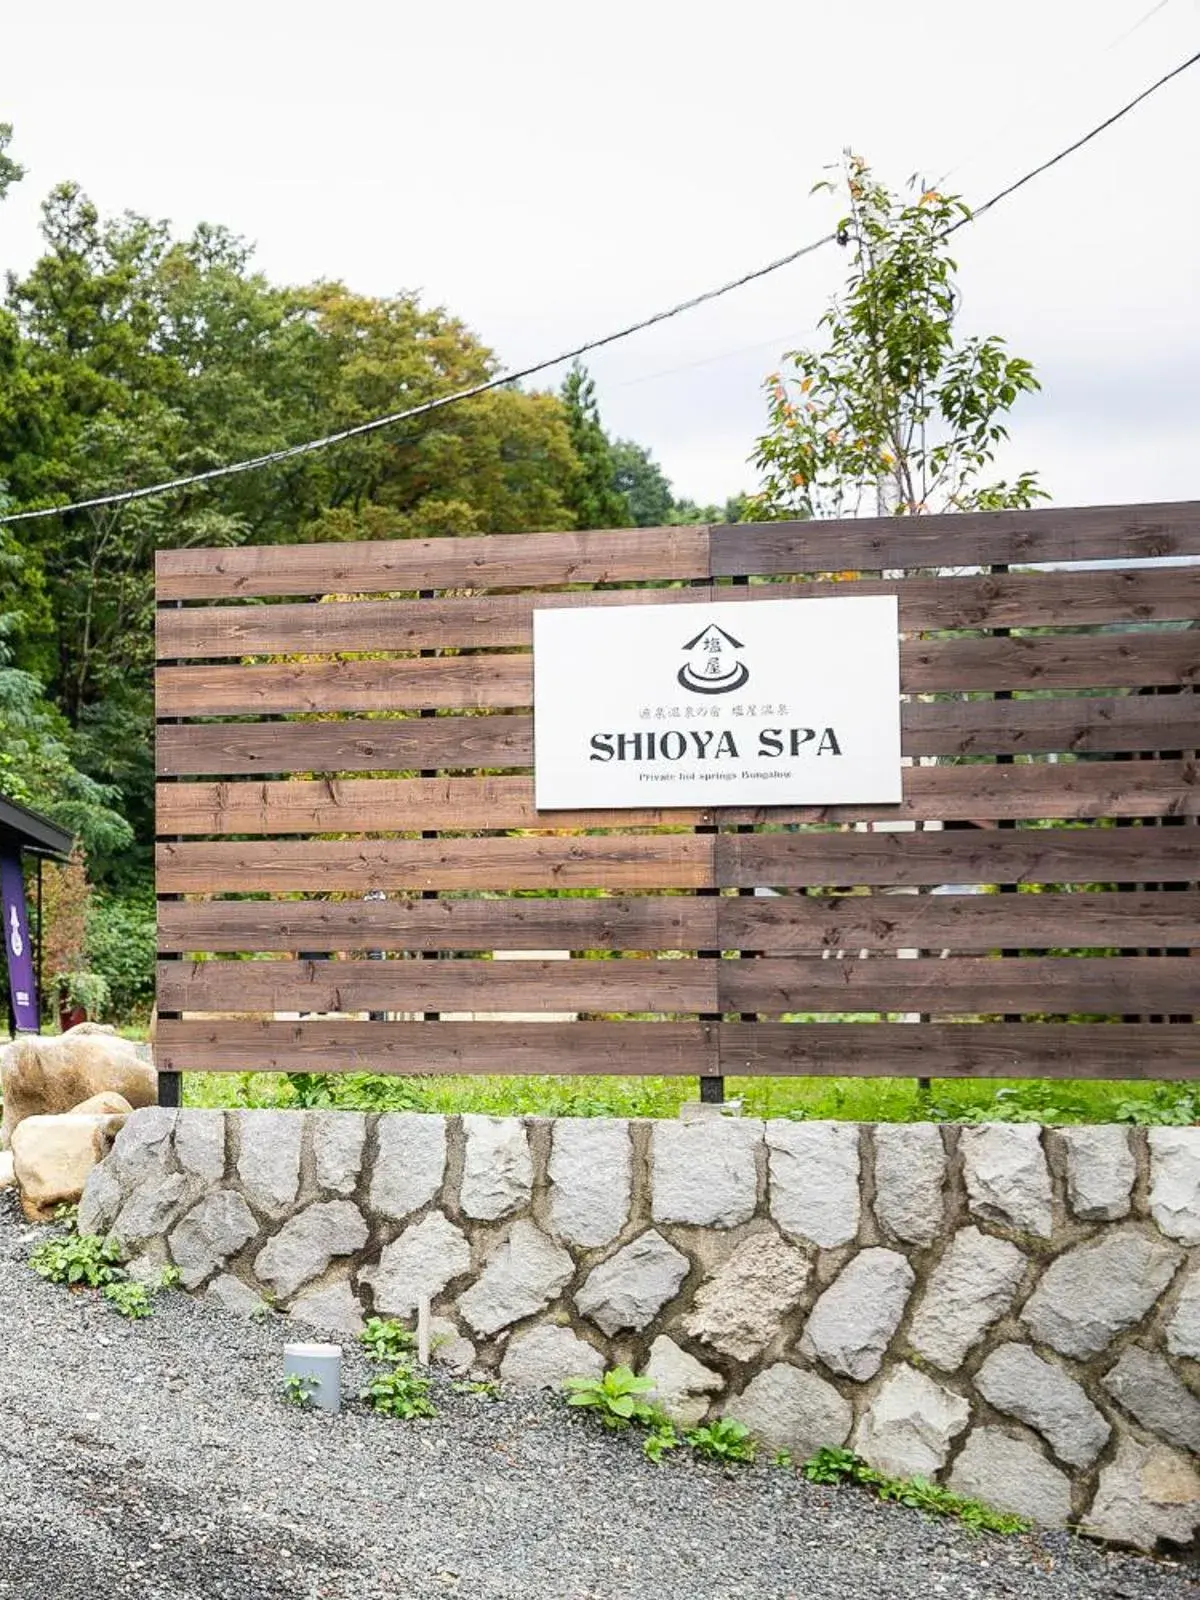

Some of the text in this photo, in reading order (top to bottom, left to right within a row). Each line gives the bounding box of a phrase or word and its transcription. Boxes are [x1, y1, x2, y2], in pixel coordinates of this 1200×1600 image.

[589, 727, 842, 762] SHIOYA SPA
[639, 772, 676, 782] Private
[678, 771, 696, 781] hot
[699, 771, 738, 782] springs
